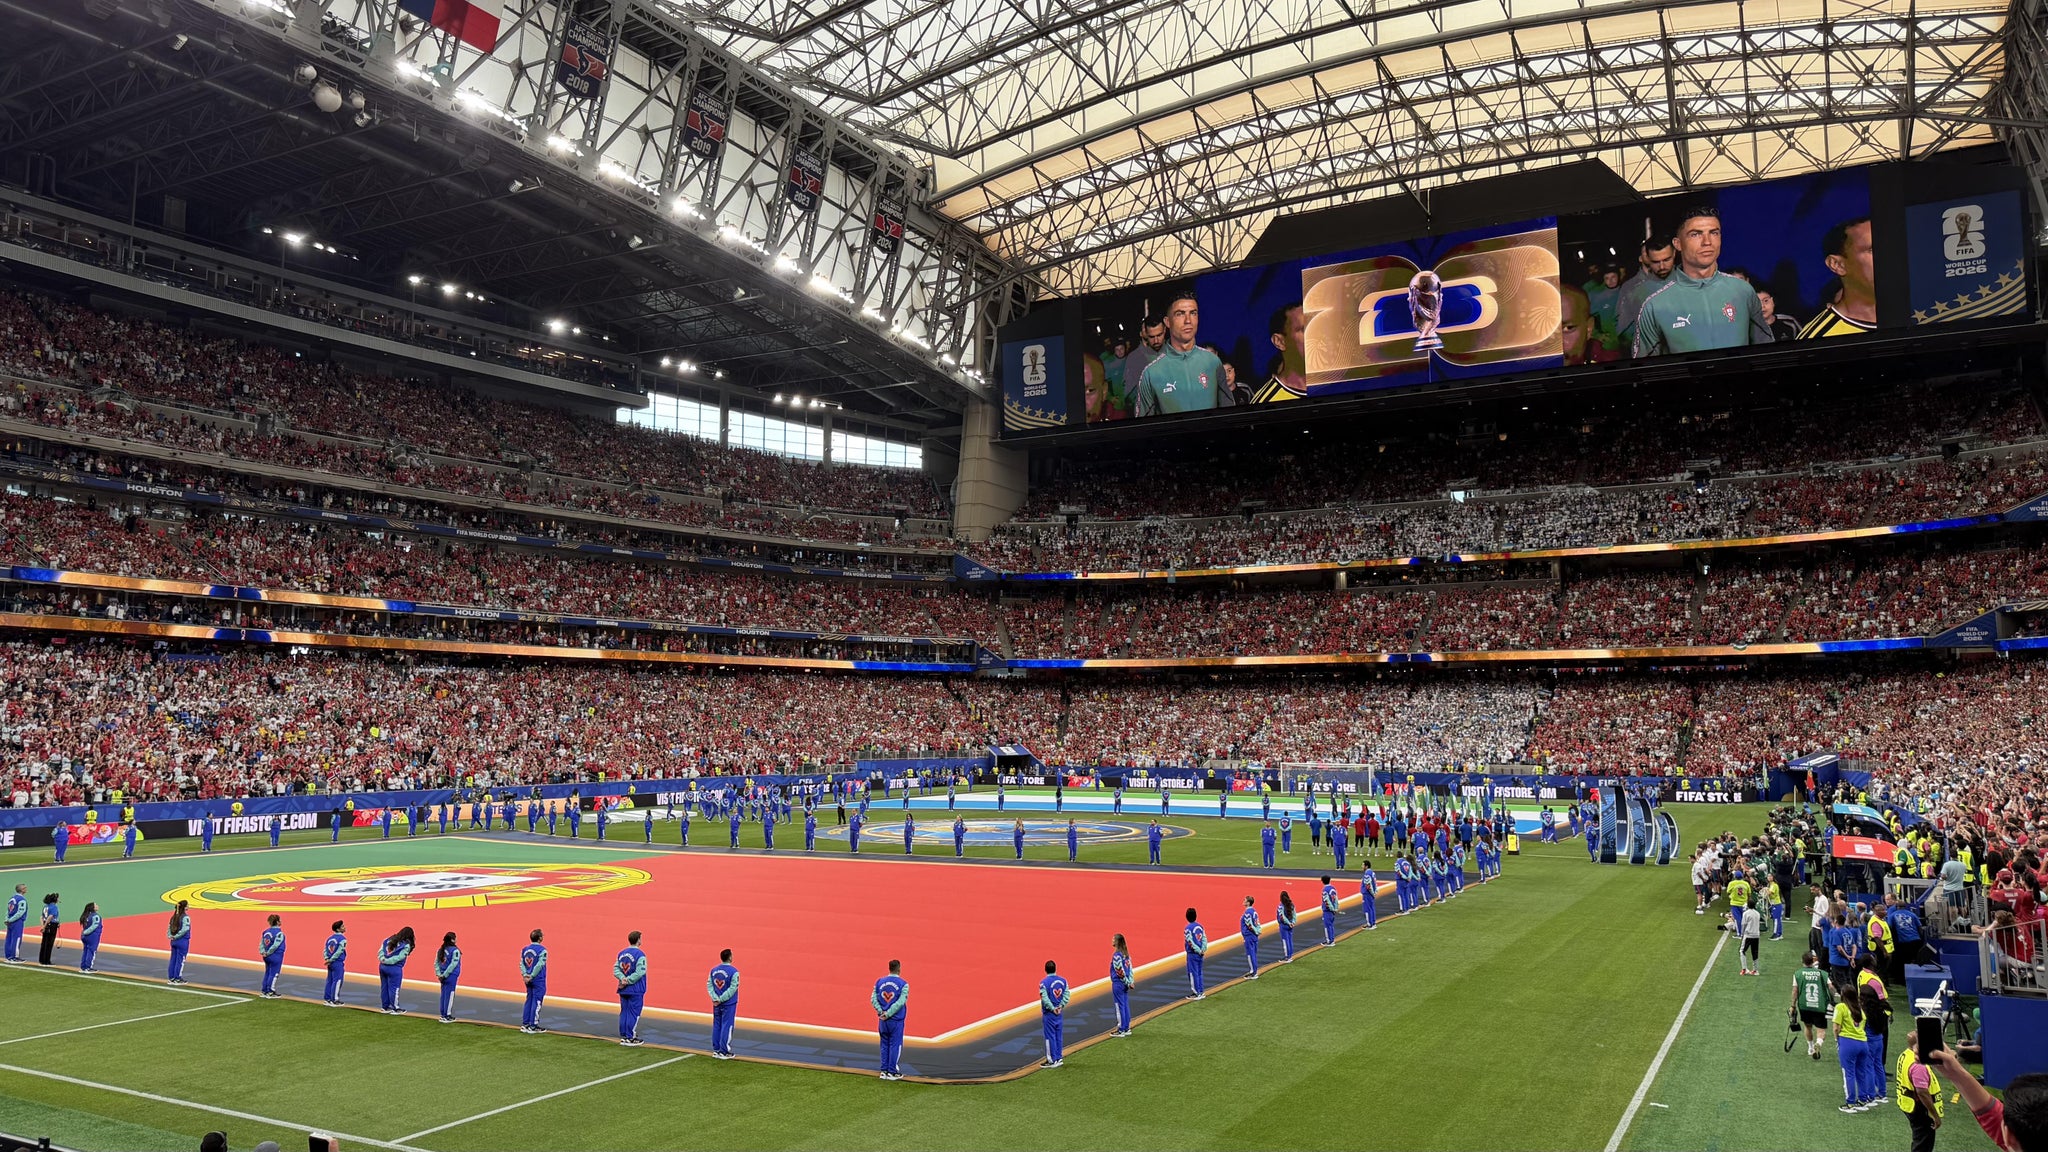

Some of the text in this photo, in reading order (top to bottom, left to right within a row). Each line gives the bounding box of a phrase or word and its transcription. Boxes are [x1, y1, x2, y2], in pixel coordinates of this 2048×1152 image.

[574, 24, 604, 46] AFC SOUTH
[568, 29, 607, 56] CHAMPIONS
[566, 73, 590, 94] 2018
[692, 96, 726, 120] CHAMPIONS
[691, 137, 711, 155] 2019
[794, 191, 810, 207] 2023
[1956, 248, 1975, 256] FIFA
[1945, 258, 1987, 269] WORLD CUP
[1945, 265, 1987, 278] 2026
[1023, 389, 1047, 397] 2026
[127, 483, 183, 498] HOUSTON
[456, 529, 468, 537] FIFA
[499, 534, 517, 542] 2026
[731, 561, 764, 569] HOUSTON
[455, 609, 500, 618] HOUSTON
[1129, 778, 1147, 788] VISIT
[1462, 785, 1485, 797] VISIT
[1676, 791, 1705, 801] FIFA
[2008, 899, 2017, 910] 7
